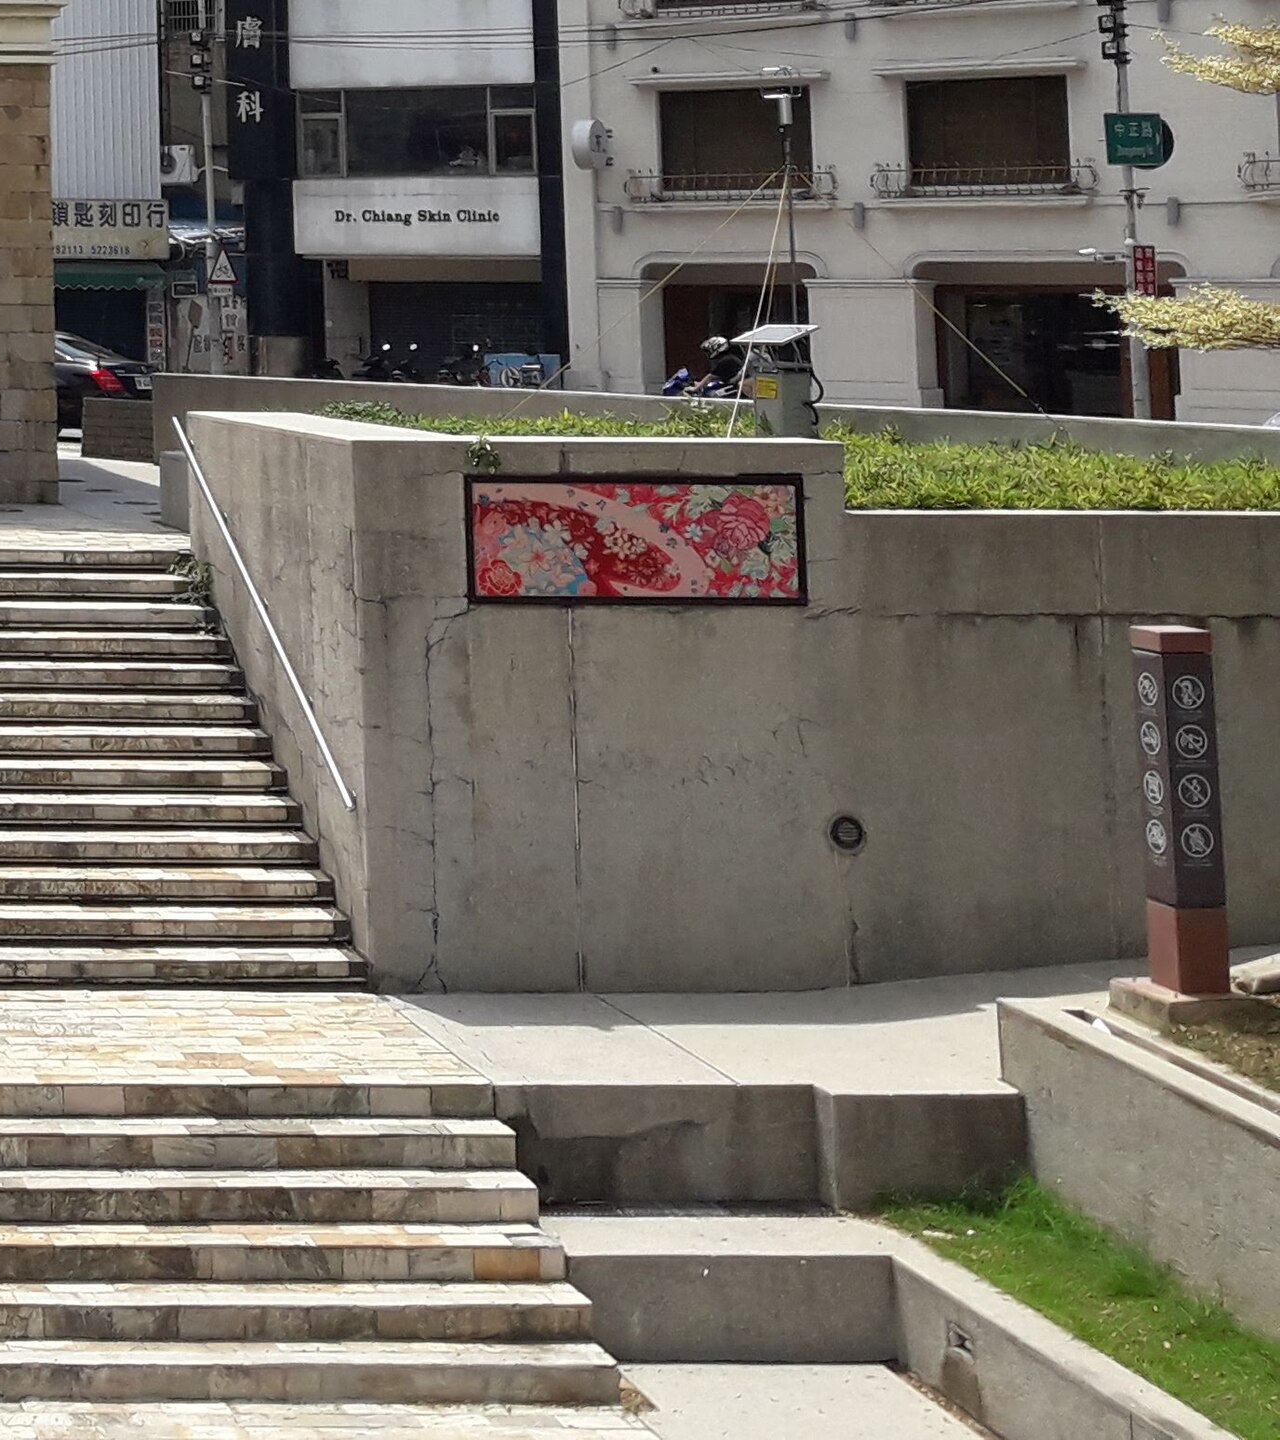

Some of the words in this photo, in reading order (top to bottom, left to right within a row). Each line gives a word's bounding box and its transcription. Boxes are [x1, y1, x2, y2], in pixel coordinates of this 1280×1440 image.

[52, 201, 165, 228] 鎖匙刻印行
[335, 210, 357, 222] Dr.
[362, 210, 412, 226] Chiang
[417, 210, 452, 222] Skin
[456, 210, 500, 222] Clinic
